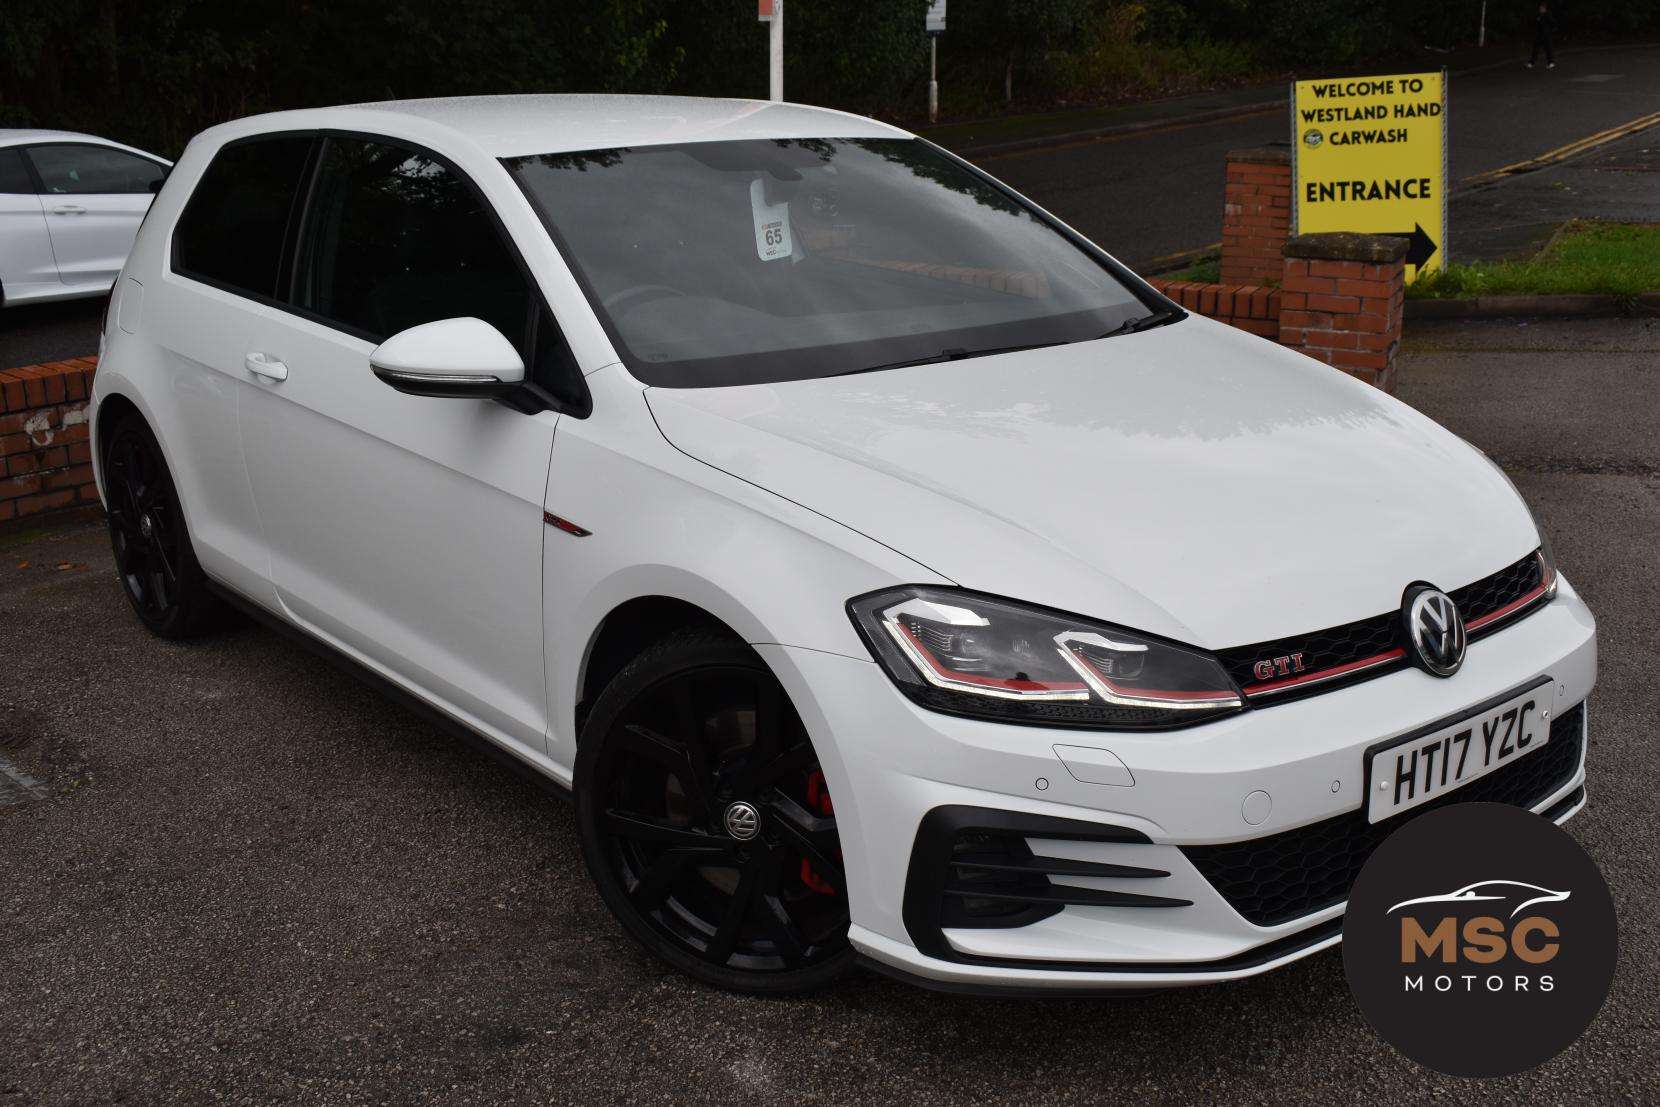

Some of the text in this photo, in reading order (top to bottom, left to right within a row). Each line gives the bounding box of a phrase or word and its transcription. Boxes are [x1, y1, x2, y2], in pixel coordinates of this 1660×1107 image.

[1312, 79, 1423, 98] WELCOME TO
[1301, 102, 1441, 123] WESTLAND HAND
[1329, 128, 1408, 146] CARWASH
[1306, 178, 1431, 203] ENTRANCE
[765, 228, 783, 246] 65
[1253, 652, 1306, 680] GTI
[1393, 700, 1536, 806] HT17 YZC
